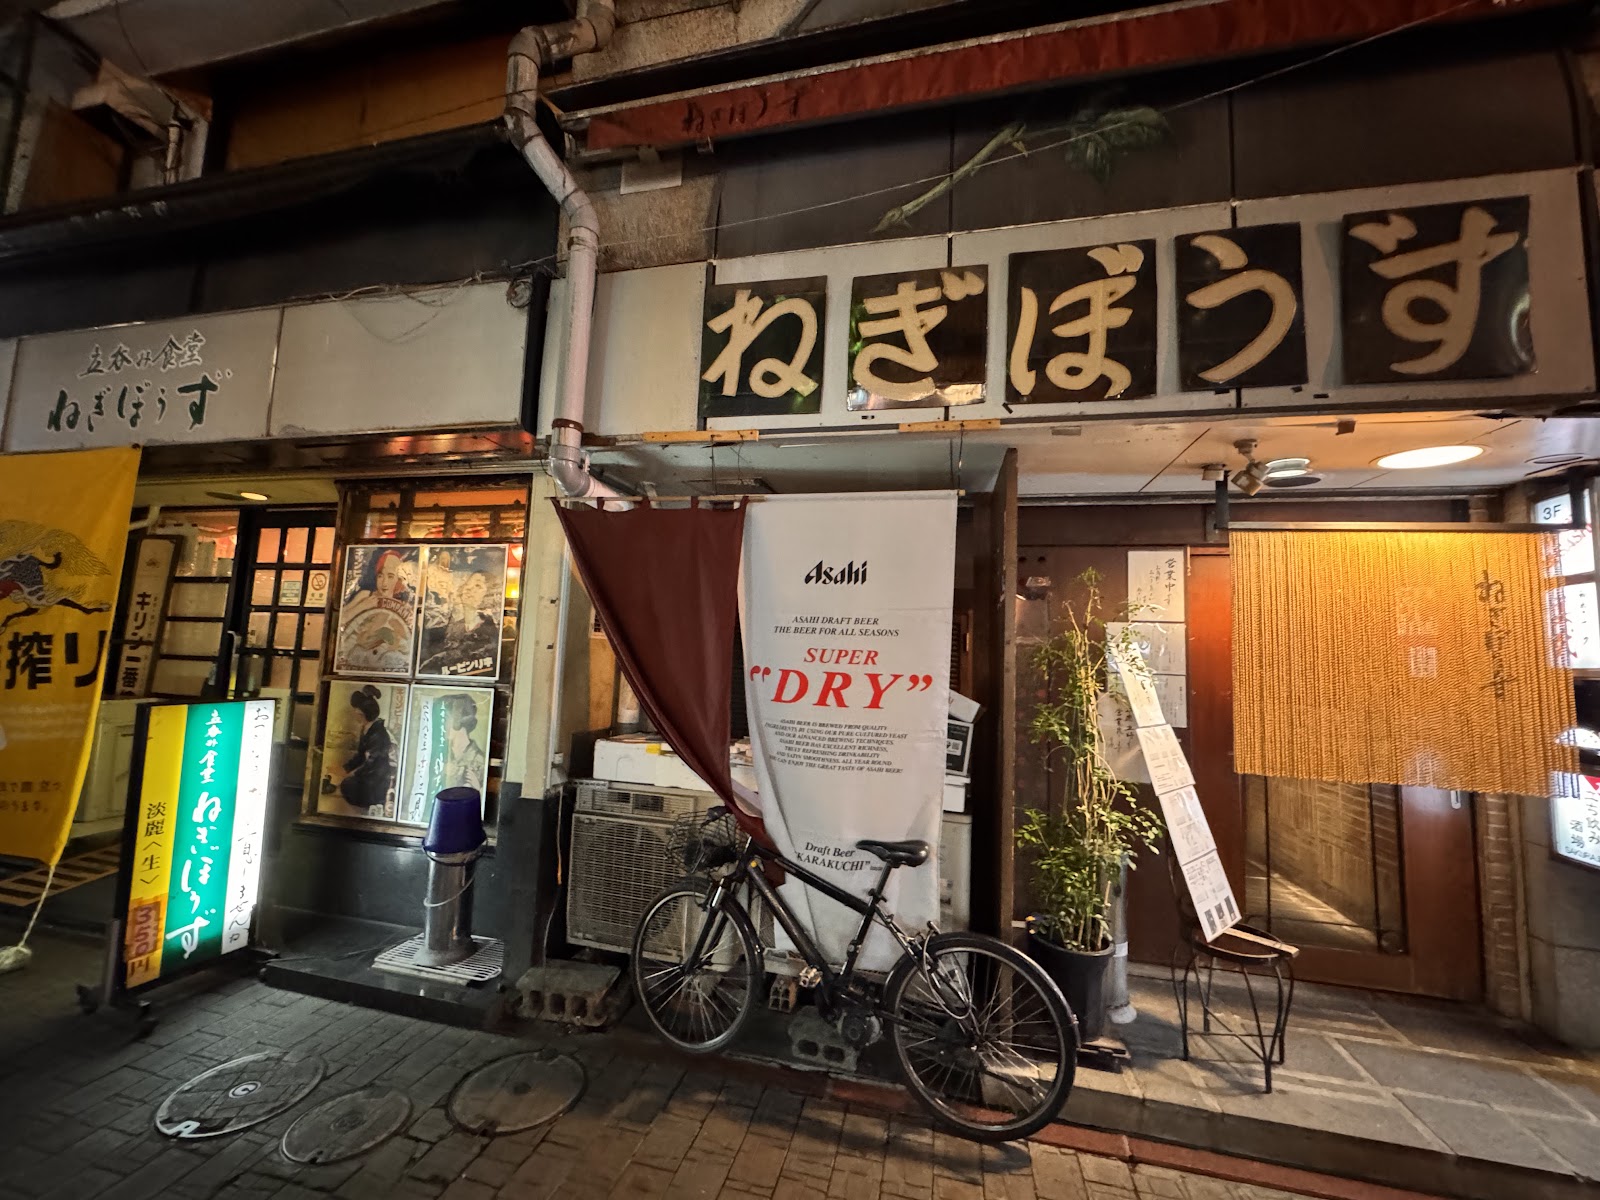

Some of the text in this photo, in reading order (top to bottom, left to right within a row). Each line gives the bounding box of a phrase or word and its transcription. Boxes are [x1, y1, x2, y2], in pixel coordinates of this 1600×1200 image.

[702, 206, 1519, 401] ねぎぼうず
[47, 369, 233, 433] ねぎぼうず
[1543, 504, 1562, 521] 3F
[804, 560, 868, 585] Asahi
[792, 615, 880, 626] ASAHI DRAFT BEER
[773, 625, 900, 637] THE BEER FOR ALL SEASONS
[803, 647, 879, 666] SUPER
[805, 842, 856, 857] Draft Beer
[165, 791, 222, 960] ねぎぼうず
